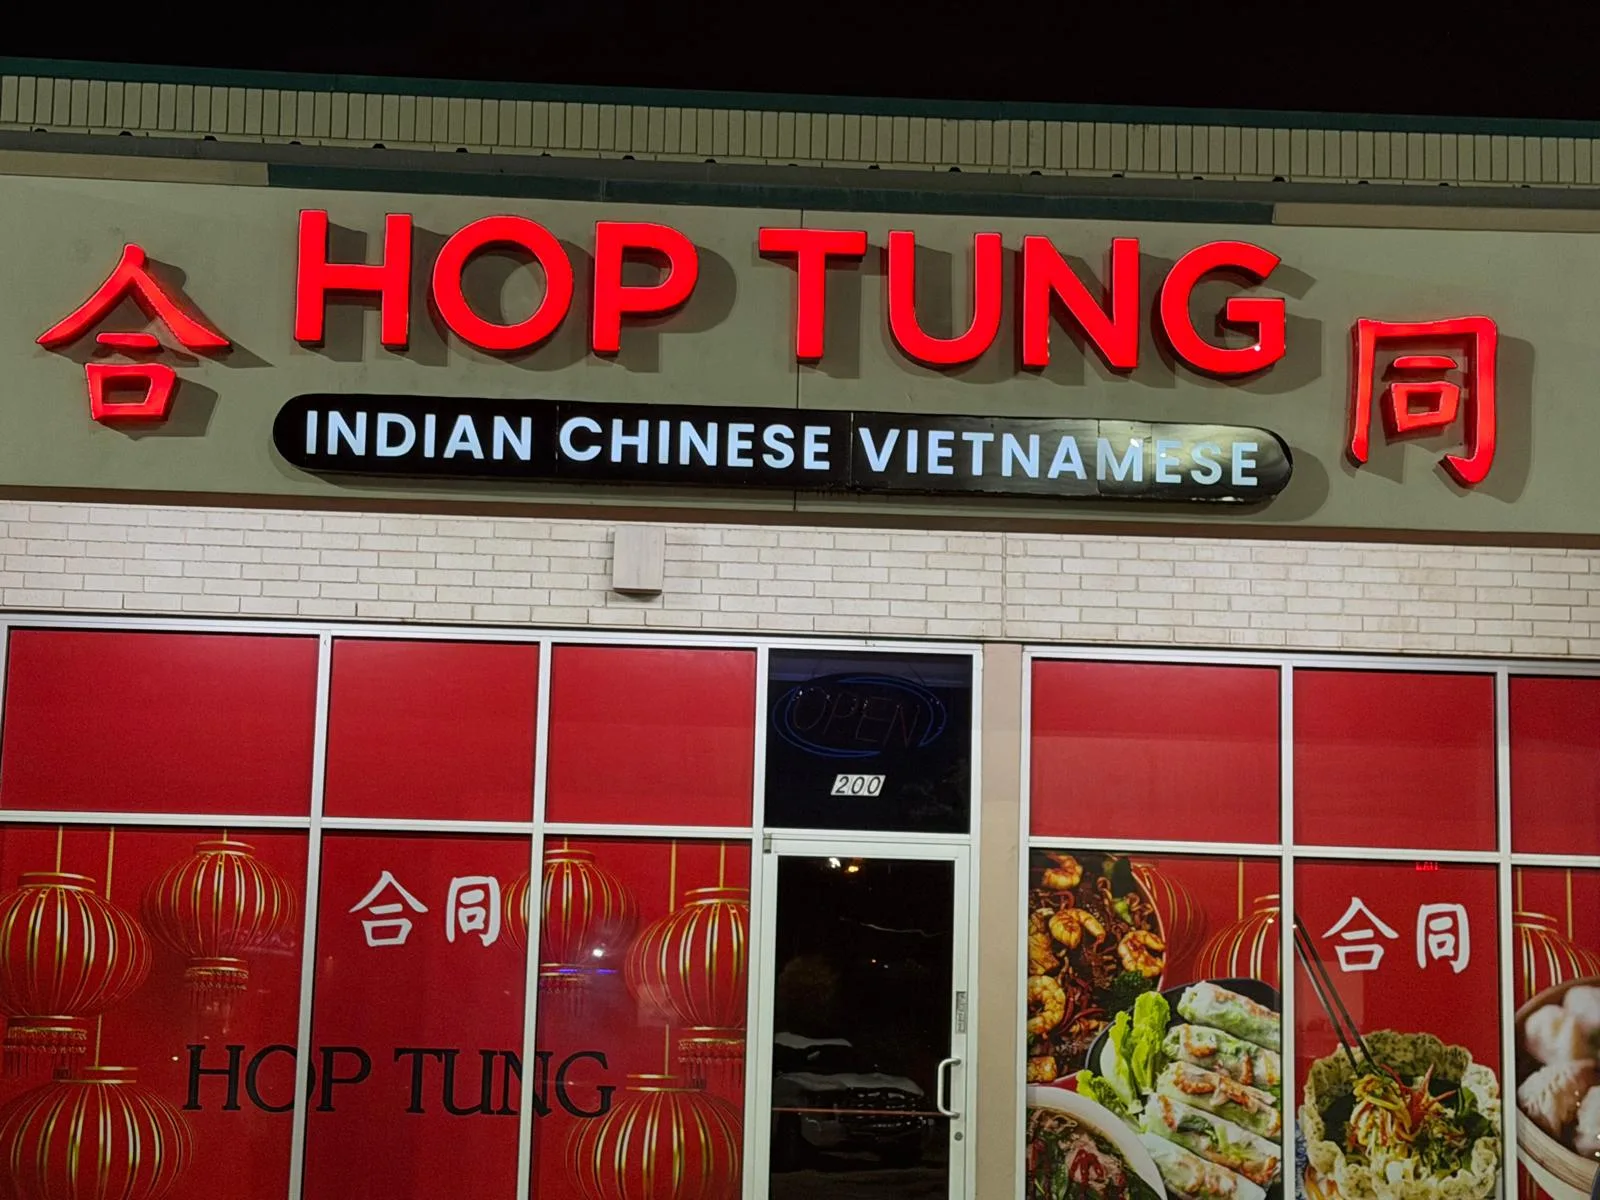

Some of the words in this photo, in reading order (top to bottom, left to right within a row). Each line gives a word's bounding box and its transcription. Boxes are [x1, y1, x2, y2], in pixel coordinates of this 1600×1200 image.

[37, 242, 232, 421] 合
[294, 209, 699, 356] HOP
[758, 227, 1286, 376] TUNG
[1350, 315, 1499, 483] 同
[306, 409, 533, 462] INDIAN
[559, 416, 832, 471] CHINESE
[857, 425, 1259, 487] VIETNAMESE
[792, 685, 921, 749] OPEN
[835, 775, 882, 795] 200
[349, 869, 501, 948] 合同
[1322, 896, 1470, 974] 合同
[182, 1043, 373, 1114] HOP
[392, 1046, 617, 1119] TUNG
